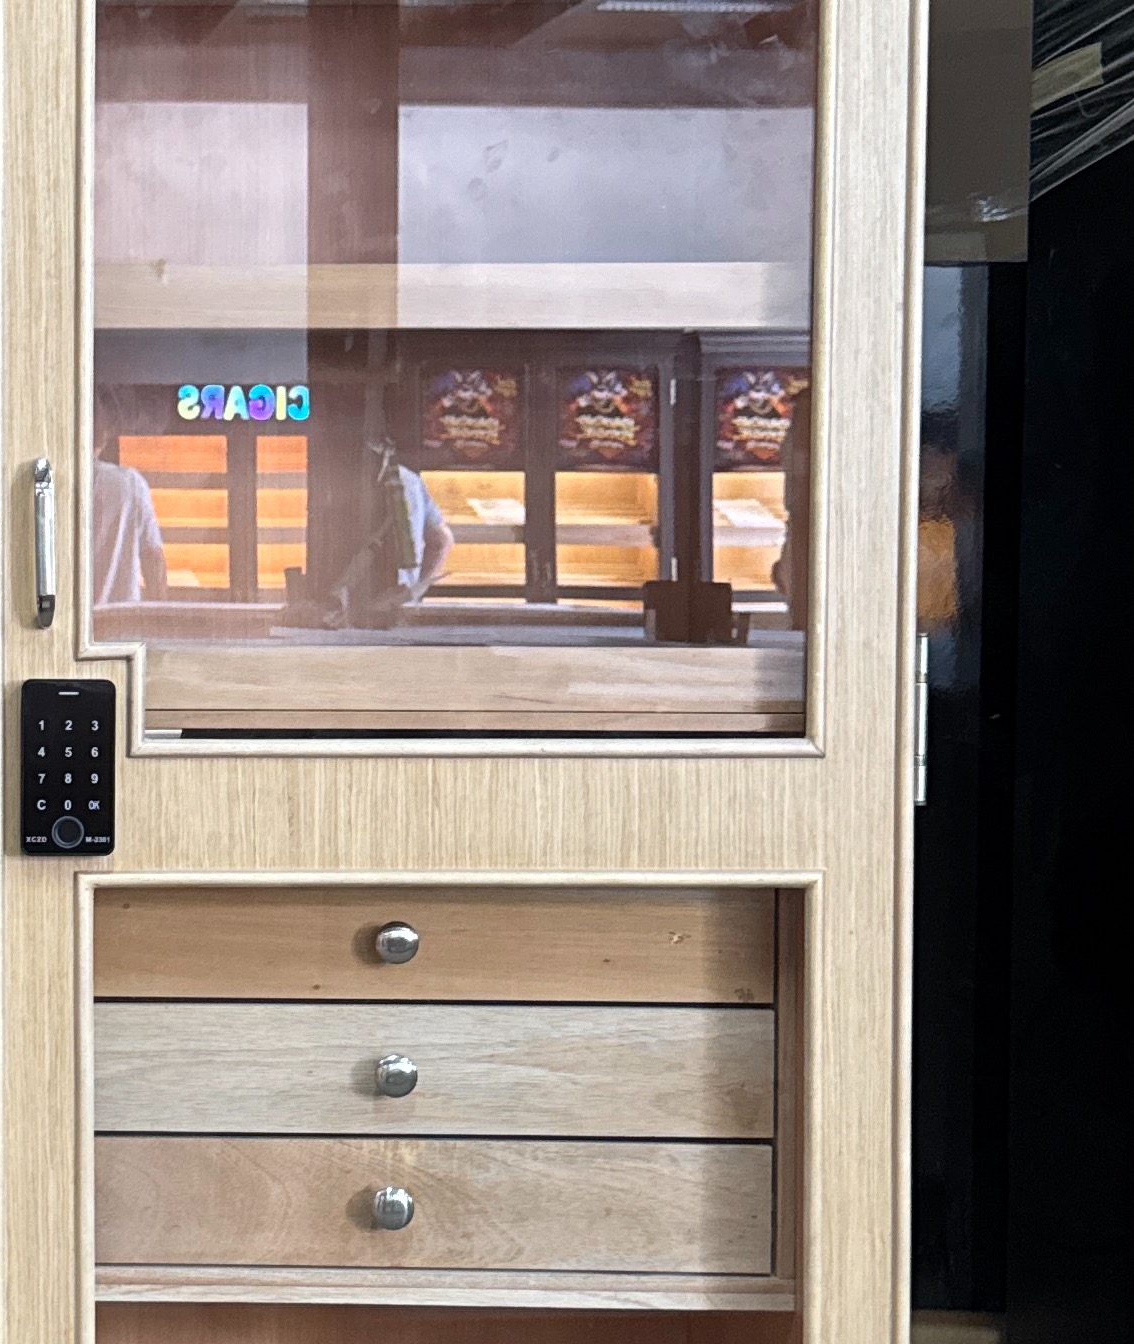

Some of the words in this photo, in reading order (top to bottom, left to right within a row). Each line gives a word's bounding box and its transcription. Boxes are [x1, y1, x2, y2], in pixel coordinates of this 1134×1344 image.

[38, 720, 45, 731] 1
[64, 720, 73, 731] 2
[91, 720, 99, 731] 3
[38, 747, 46, 757] 4
[65, 747, 72, 757] 5
[91, 747, 99, 757] 6
[38, 773, 46, 784] 7
[64, 773, 72, 784] 8
[91, 773, 99, 784] 9
[37, 799, 46, 810] C
[88, 800, 100, 810] OK
